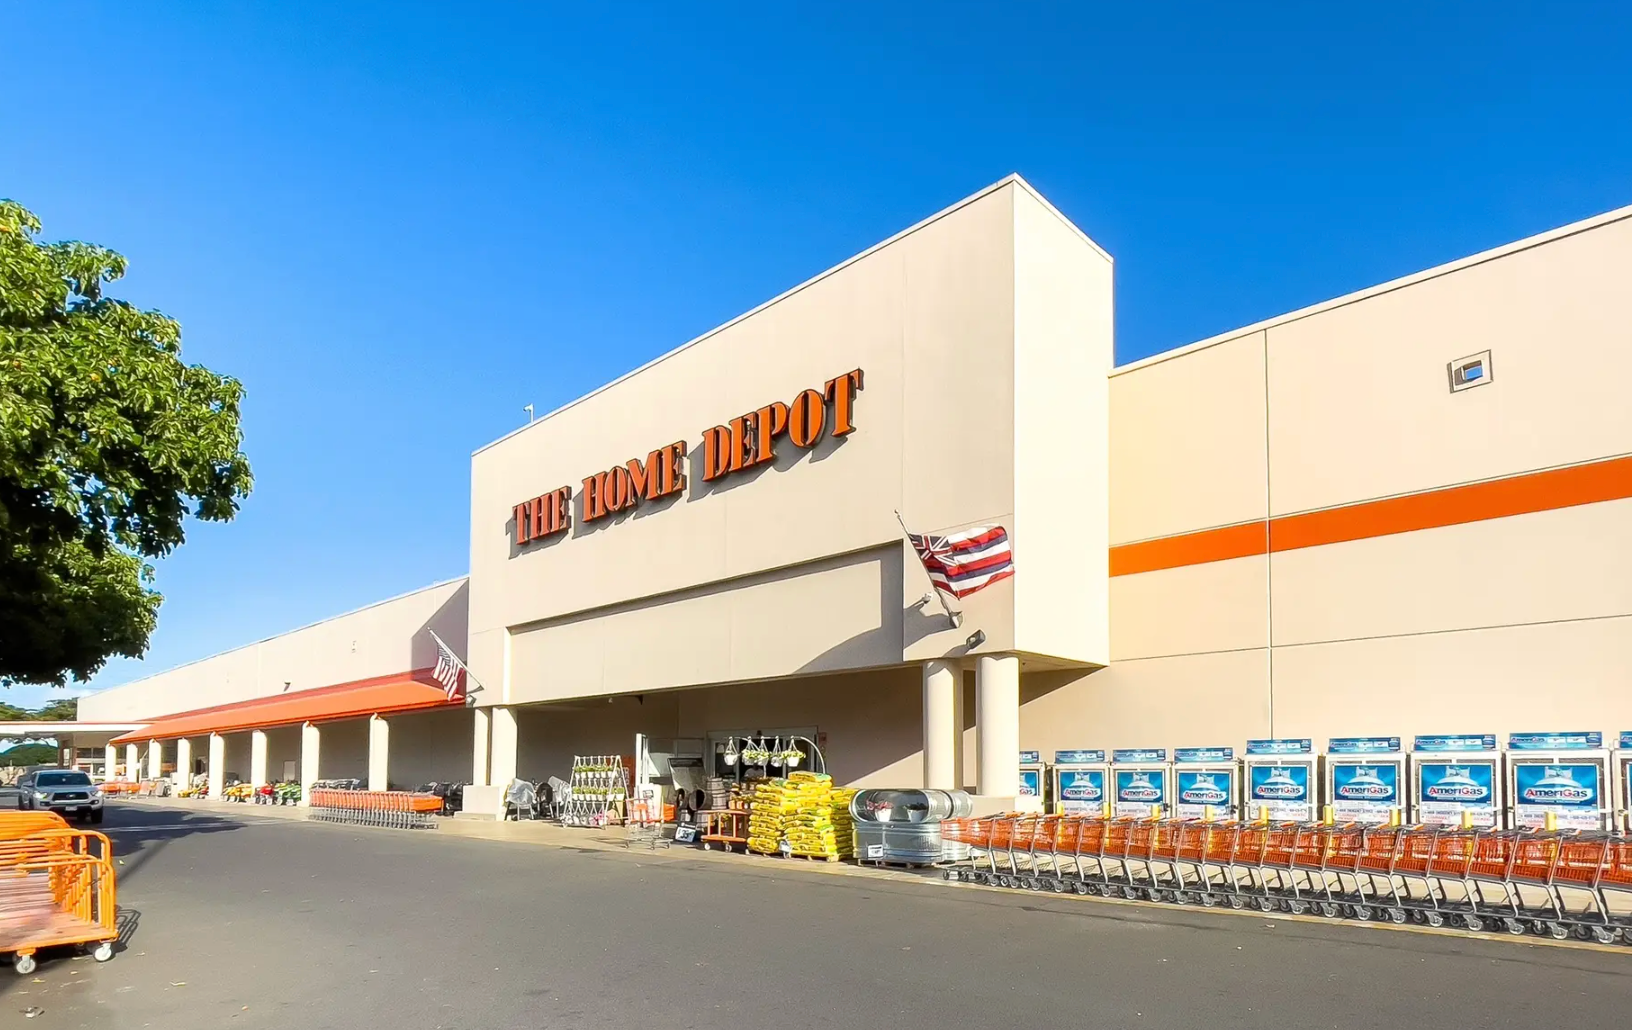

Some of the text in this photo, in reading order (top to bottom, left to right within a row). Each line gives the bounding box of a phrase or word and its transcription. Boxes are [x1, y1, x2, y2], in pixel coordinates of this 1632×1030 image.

[513, 368, 864, 545] THE HOME DEPOT
[1257, 786, 1301, 794] AmeriGas
[1341, 786, 1389, 794] AmeriGas
[1428, 787, 1483, 795] AmeriGas
[1525, 788, 1588, 798] AmeriGas
[1184, 791, 1223, 799] AmeriGas
